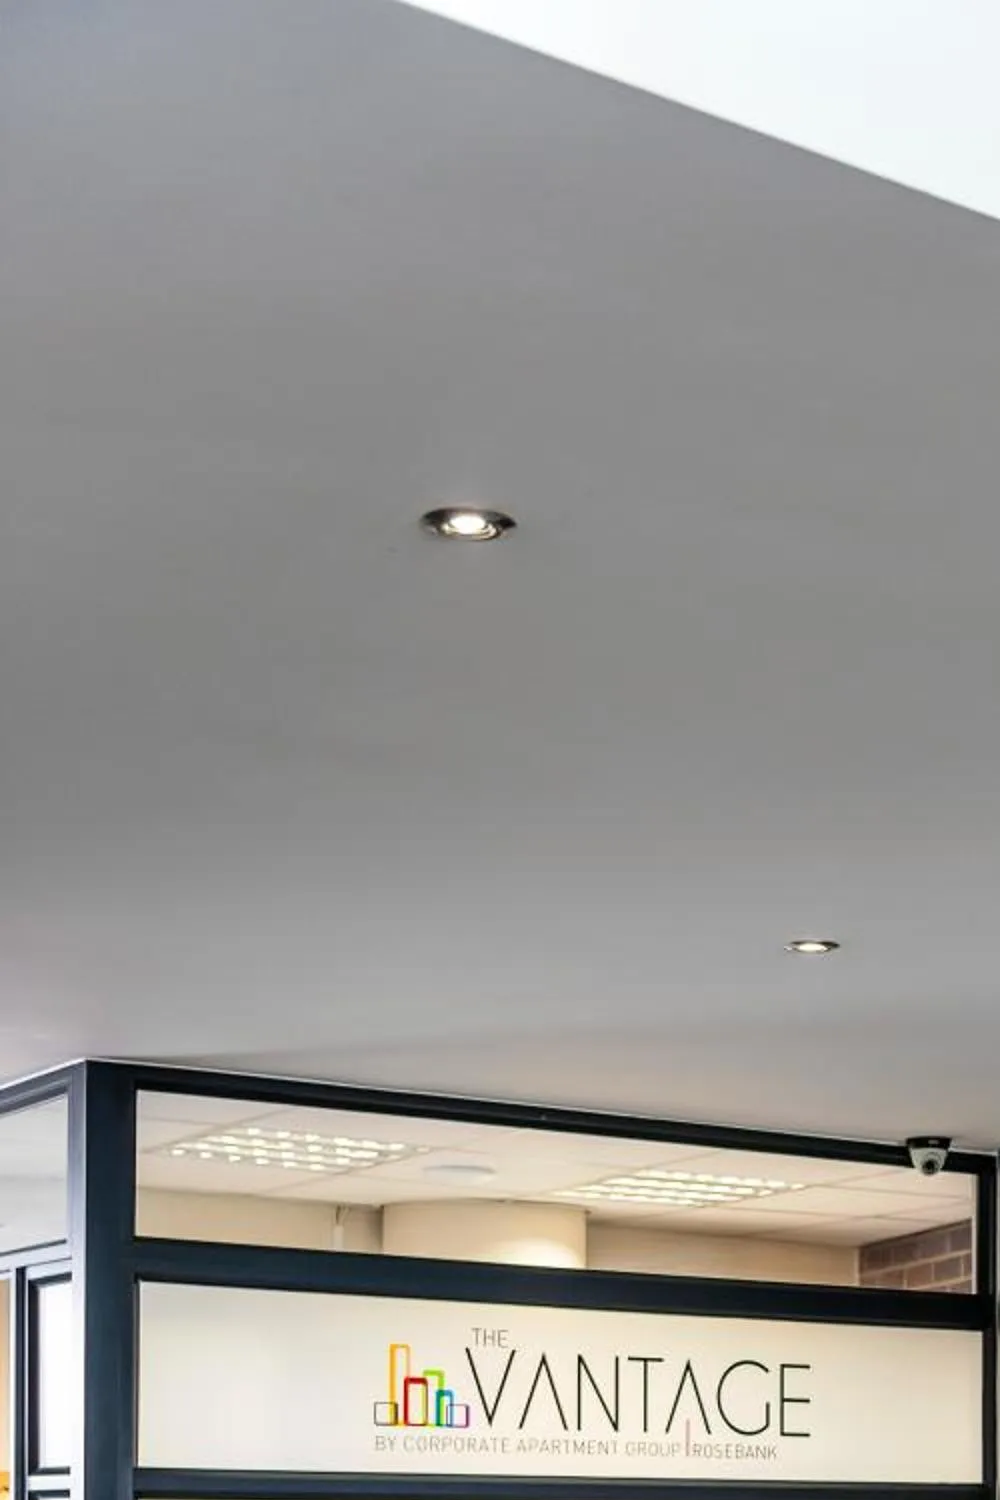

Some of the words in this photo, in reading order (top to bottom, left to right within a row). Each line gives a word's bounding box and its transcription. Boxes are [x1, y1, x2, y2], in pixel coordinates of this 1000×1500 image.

[472, 1327, 510, 1349] THE
[465, 1346, 811, 1438] VANTAGE
[374, 1434, 397, 1452] BY
[402, 1436, 511, 1455] CORPORATE
[516, 1438, 619, 1457] APARTMENT
[625, 1441, 681, 1458] GROUP
[693, 1442, 778, 1461] ROSEBANK
